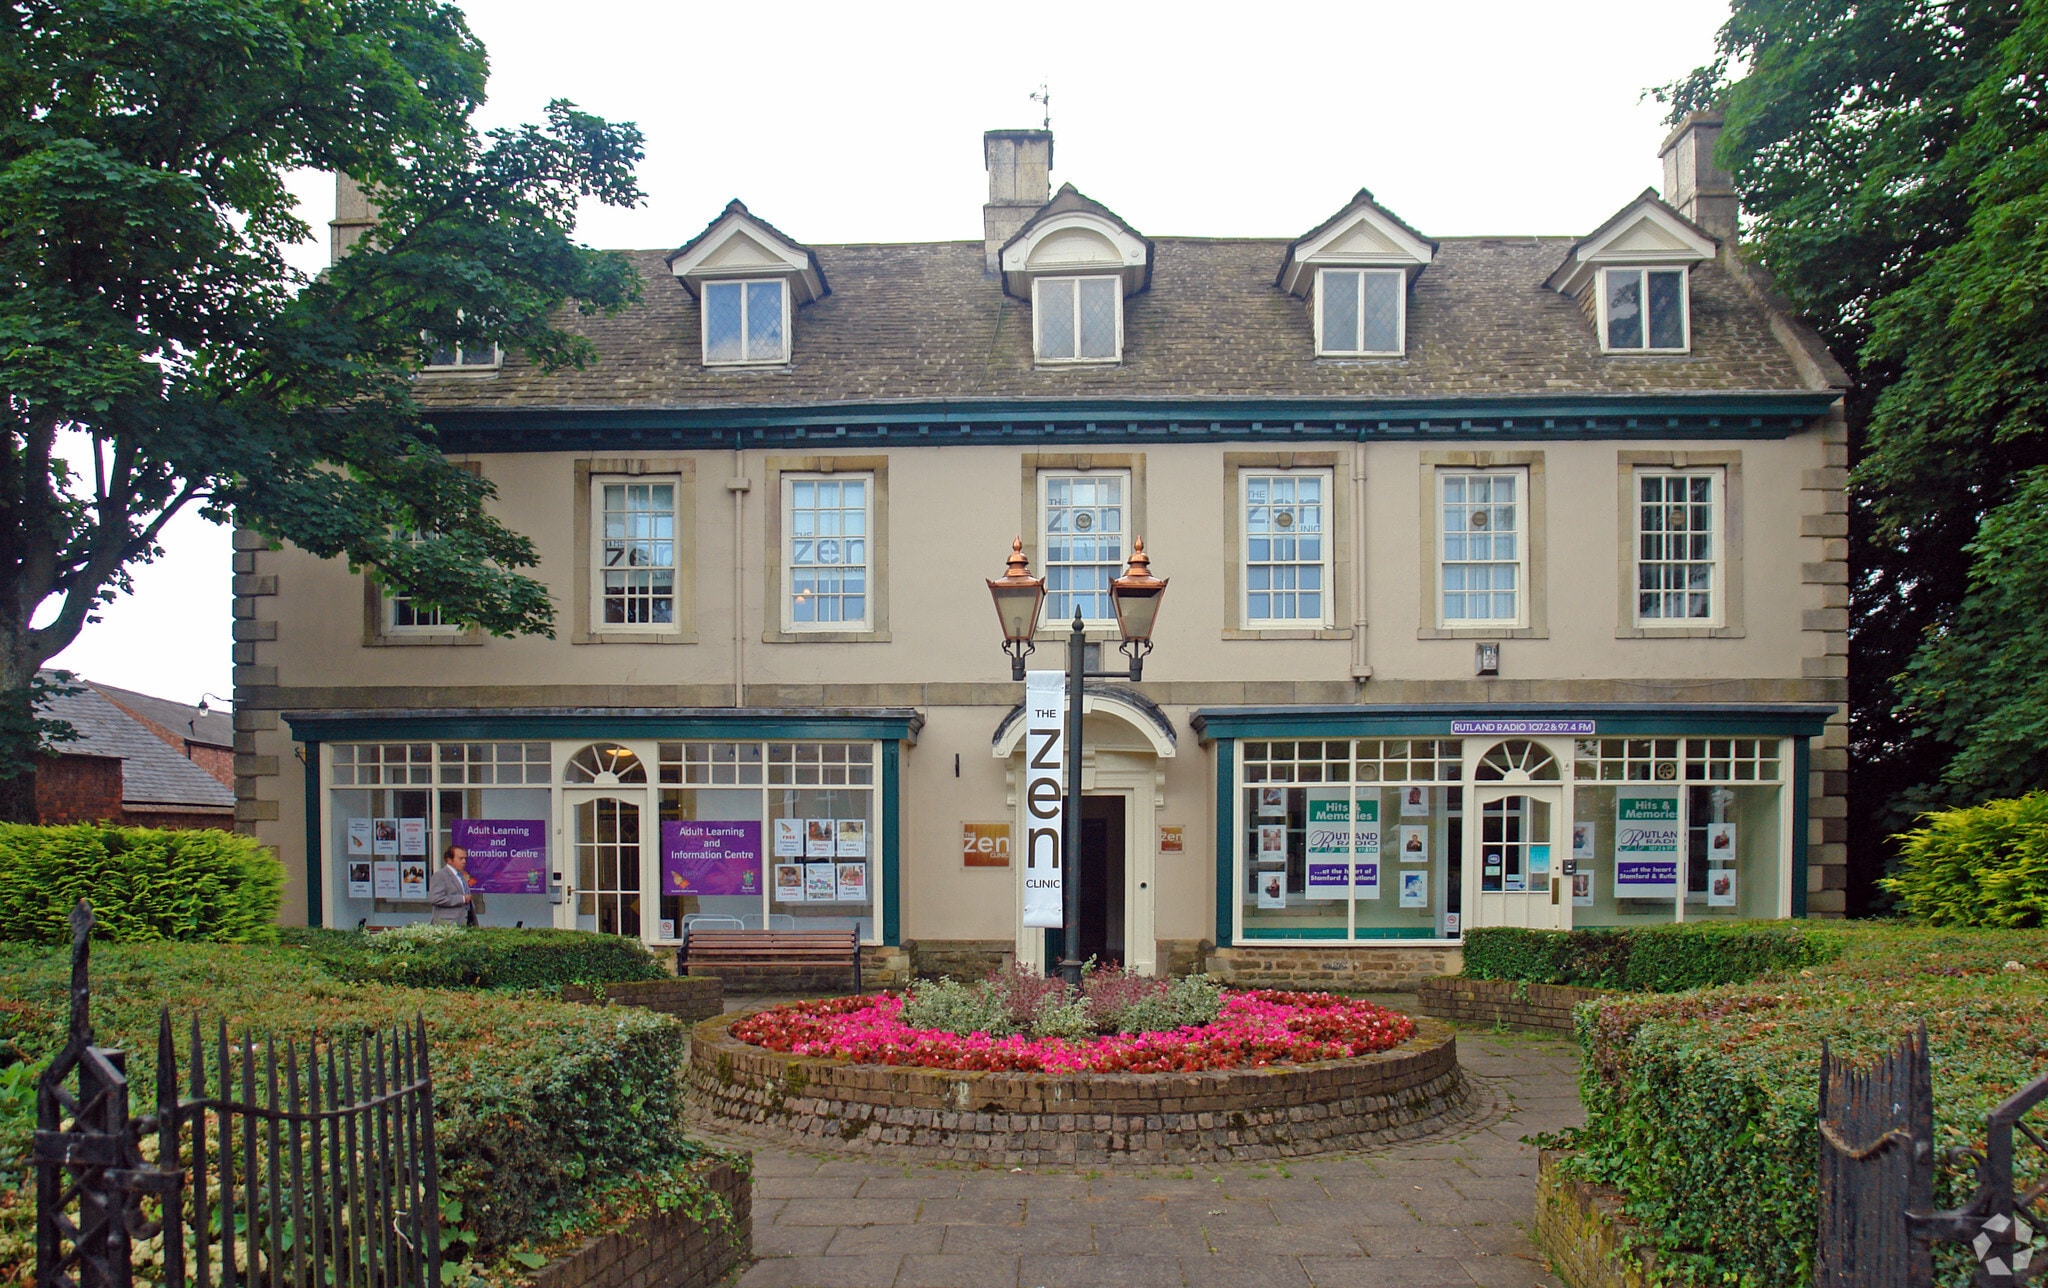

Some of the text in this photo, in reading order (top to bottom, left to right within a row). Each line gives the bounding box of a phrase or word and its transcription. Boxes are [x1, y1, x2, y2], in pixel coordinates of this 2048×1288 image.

[1248, 490, 1265, 498] THE
[1048, 498, 1068, 506] THE
[794, 539, 865, 565] zen
[1035, 709, 1056, 718] THE
[1454, 723, 1495, 731] RUTLAND
[1497, 723, 1526, 731] RADIO
[1578, 723, 1592, 731] FM
[1027, 729, 1061, 869] zen
[1326, 802, 1348, 812] Hits
[1636, 801, 1670, 810] Hits &
[1316, 811, 1372, 820] Memoies
[467, 826, 529, 836] Adult Learning
[679, 827, 744, 837] Adult Learning
[1161, 832, 1182, 841] zen
[1619, 828, 1677, 850] RUTLAN
[490, 838, 506, 846] and
[703, 839, 720, 847] and
[964, 837, 1010, 853] zen
[467, 849, 538, 858] formation Centre
[671, 851, 754, 859] Information Centre
[1026, 879, 1060, 889] CLINIC
